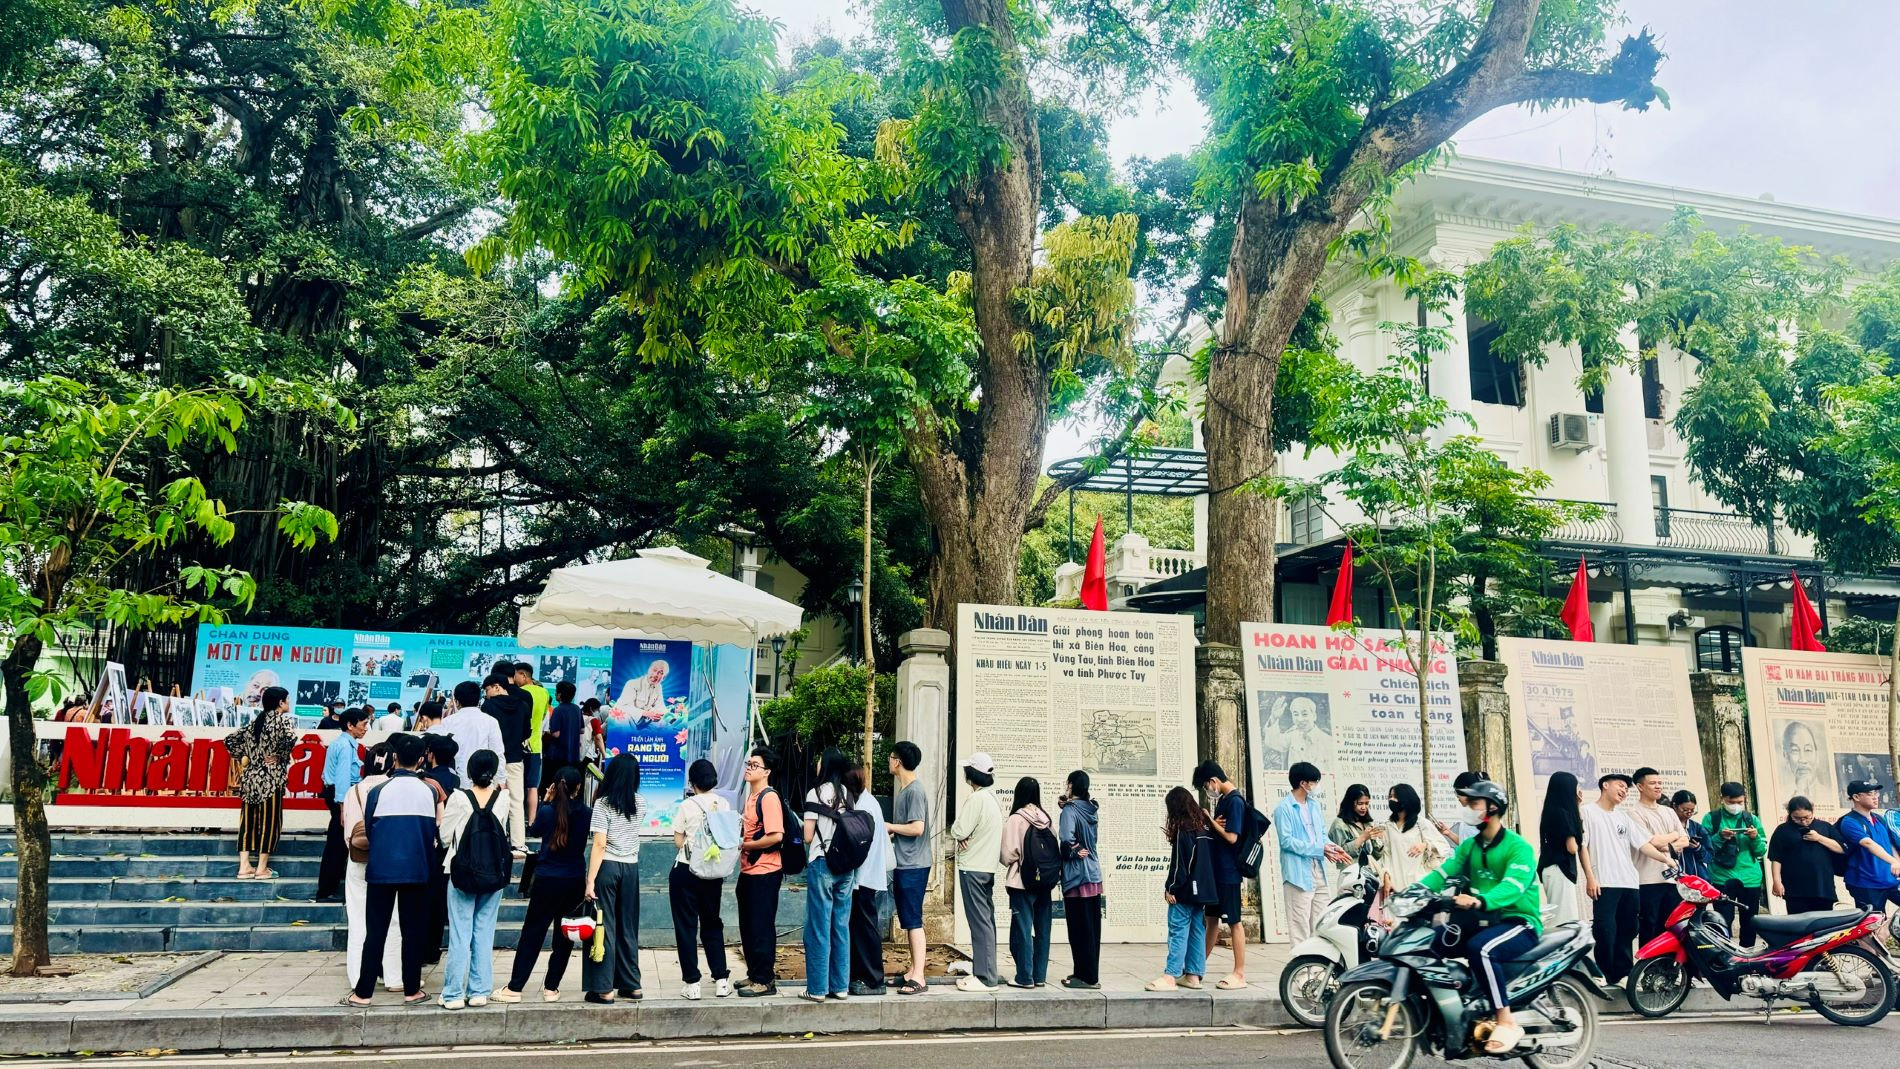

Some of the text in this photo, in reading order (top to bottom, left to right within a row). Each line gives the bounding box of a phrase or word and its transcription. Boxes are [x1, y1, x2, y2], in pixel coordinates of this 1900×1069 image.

[975, 612, 1014, 630] Nhân
[1018, 614, 1047, 632] Dân
[253, 631, 290, 640] DUNG
[1254, 632, 1316, 649] HOAN
[249, 644, 283, 661] CON
[1257, 654, 1323, 671] Nhân Dân
[1785, 668, 1793, 679] 10
[1777, 687, 1803, 702] Nhân
